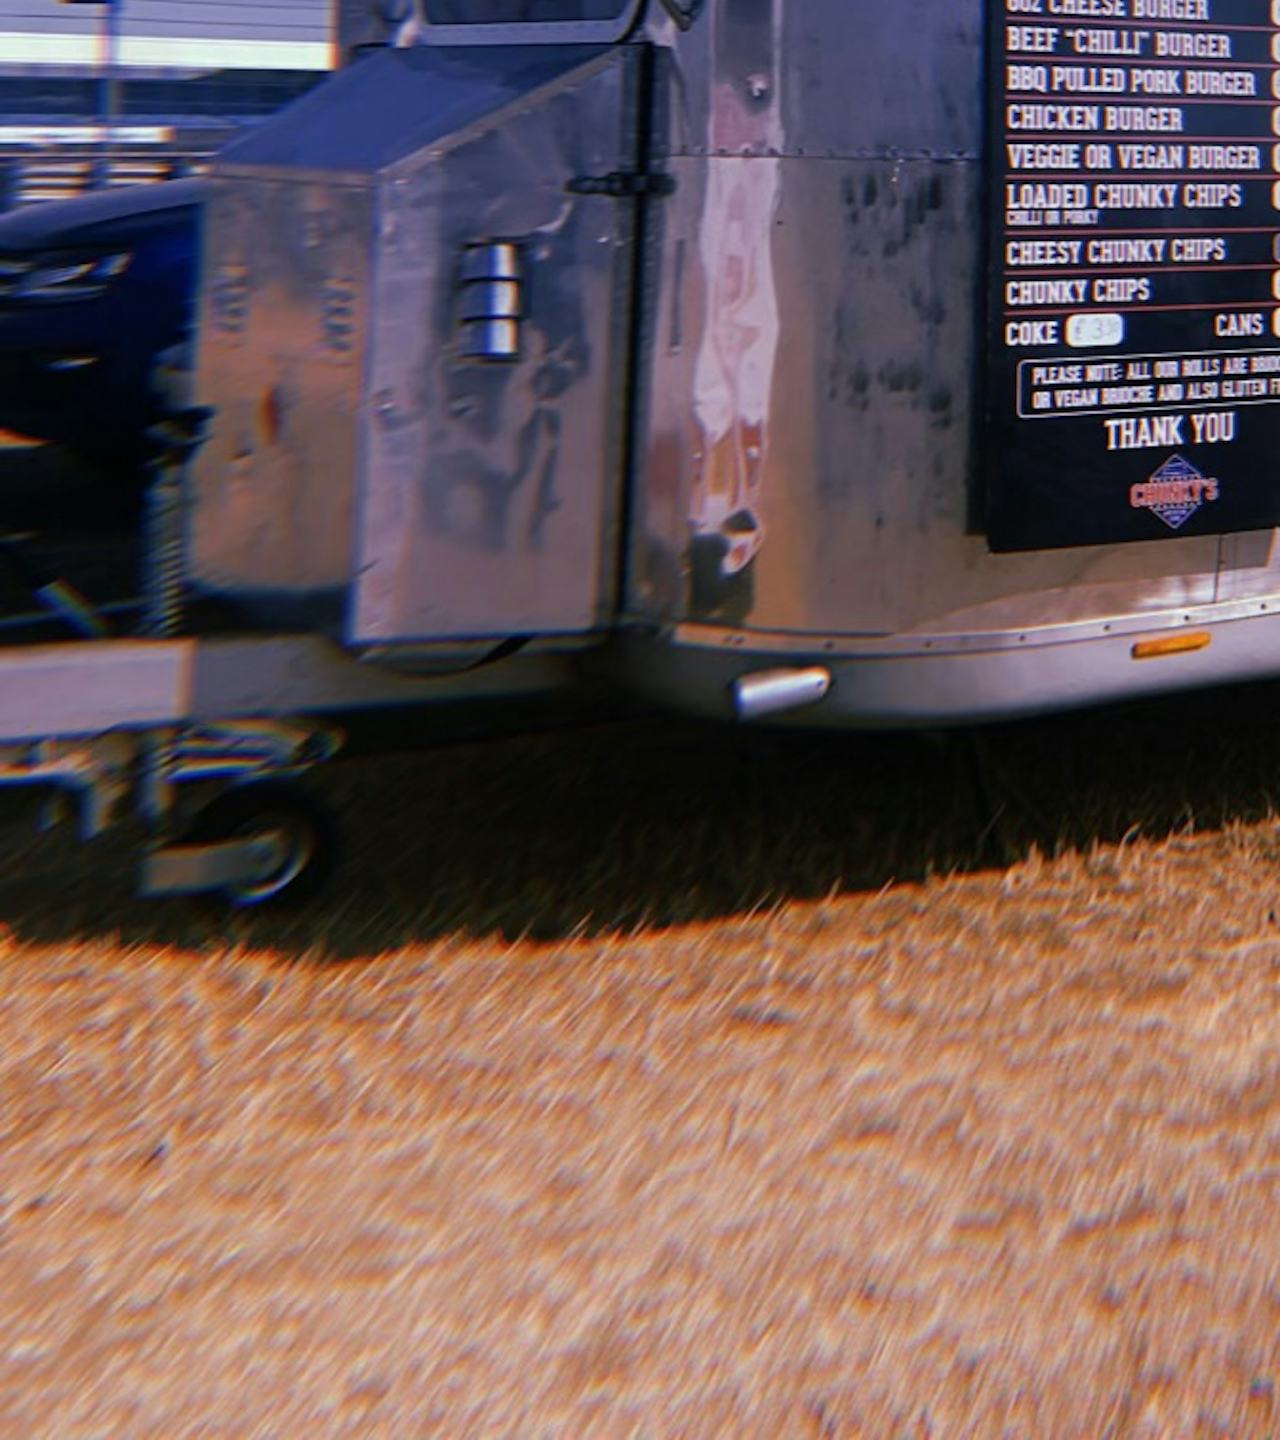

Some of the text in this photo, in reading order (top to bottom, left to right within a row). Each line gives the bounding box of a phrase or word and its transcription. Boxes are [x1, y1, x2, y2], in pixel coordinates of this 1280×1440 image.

[1006, 26, 1058, 51] BEEF
[1155, 32, 1231, 58] BURGER
[1006, 66, 1256, 95] BBQ PULLED PORK BURGER
[1006, 105, 1183, 131] CHICKEN BURGER
[1006, 144, 1260, 169] VEGGIE OR VEGAN BURGER
[1006, 183, 1241, 209] LOADED CHUNKY CHIPS
[1006, 238, 1226, 265] CHEESY CHUNKY CHIPS
[1006, 278, 1150, 305] CHUNKY CHIPS
[1005, 322, 1058, 346] COKE
[1214, 313, 1264, 337] CANS
[1031, 366, 1083, 385] PLEASE
[1085, 363, 1123, 383] NOTE:
[1125, 362, 1151, 380] ALL
[1154, 360, 1178, 378] OUR
[1181, 358, 1220, 377] ROLLS
[1223, 357, 1248, 375] ARE
[1032, 391, 1051, 409] OR
[1054, 388, 1098, 408] VEGAN
[1101, 385, 1154, 406] BRIOCHE
[1157, 383, 1183, 402] AND
[1186, 381, 1219, 400] ALSO
[1221, 379, 1267, 398] GLUTEN
[1104, 411, 1235, 450] THANK YOU
